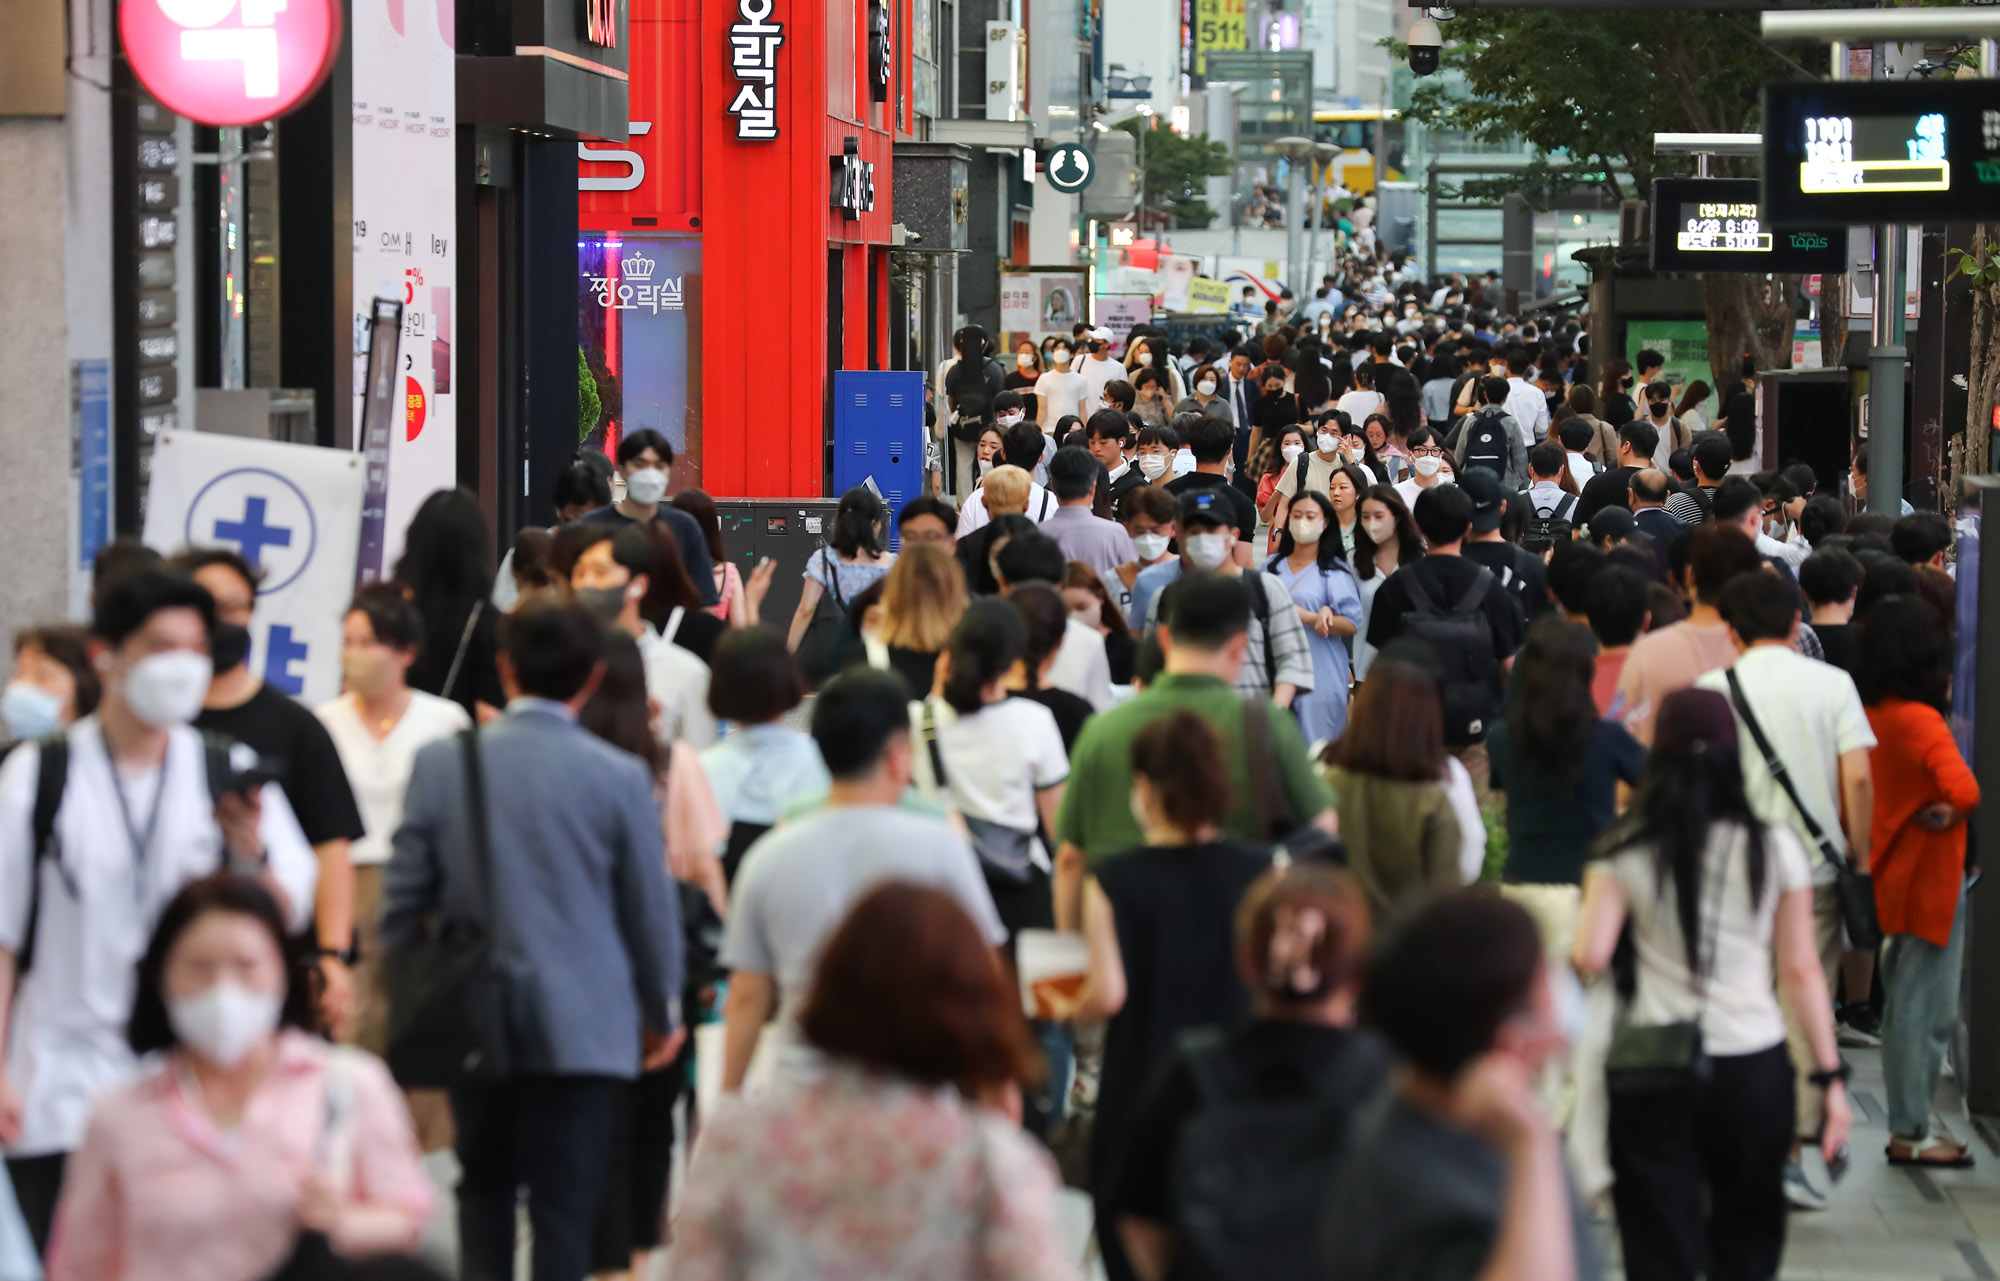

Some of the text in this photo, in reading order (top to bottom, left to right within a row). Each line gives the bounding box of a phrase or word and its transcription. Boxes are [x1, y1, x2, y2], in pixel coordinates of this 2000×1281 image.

[729, 0, 782, 138] 오락실
[1789, 235, 1828, 251] Topis
[589, 276, 684, 316] 짱오락실
